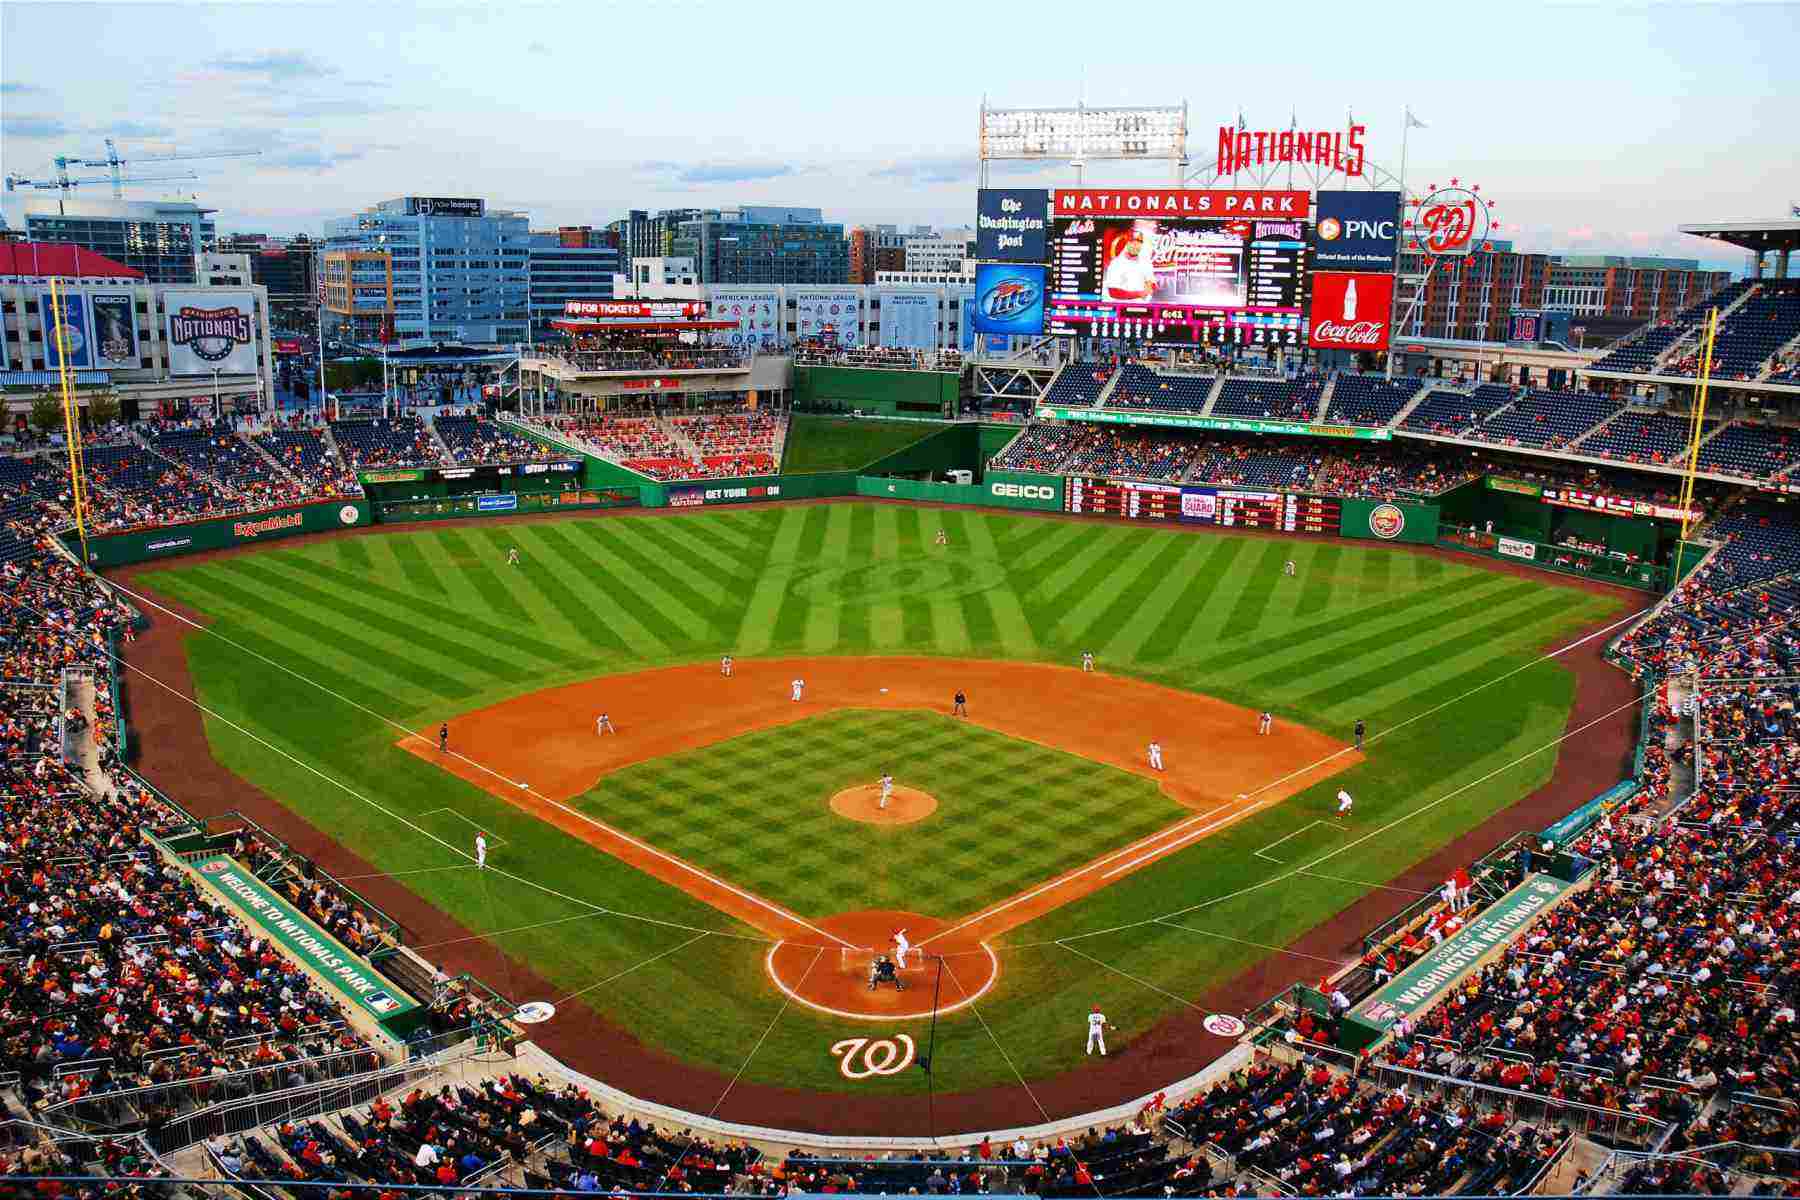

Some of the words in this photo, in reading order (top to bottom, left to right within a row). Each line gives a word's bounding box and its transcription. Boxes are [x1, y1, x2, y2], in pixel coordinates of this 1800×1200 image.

[1217, 126, 1365, 177] NATIONALS
[1001, 198, 1023, 213] The
[1063, 195, 1210, 211] NATIONALS
[1225, 196, 1295, 212] PARK
[979, 214, 1044, 232] Washington
[1343, 220, 1395, 240] PNC
[998, 234, 1024, 250] Post
[94, 296, 129, 304] GEICO
[581, 304, 599, 313] FOR
[600, 303, 641, 314] TICKETS
[173, 316, 249, 341] NATIONALS
[1254, 329, 1265, 342] 2
[1271, 331, 1280, 343] 1
[1286, 332, 1297, 344] 2
[705, 488, 722, 499] GET
[723, 487, 747, 498] YOUR
[767, 485, 780, 495] ON
[991, 482, 1055, 499] GEICO
[1184, 502, 1213, 513] GUARD
[219, 871, 267, 910] WELCOME
[264, 905, 282, 925] TO
[278, 917, 343, 970] NATIONALS
[339, 966, 377, 994] PARK
[1397, 940, 1486, 1004] WASHINGTON
[1479, 894, 1546, 944] NATIONALS
